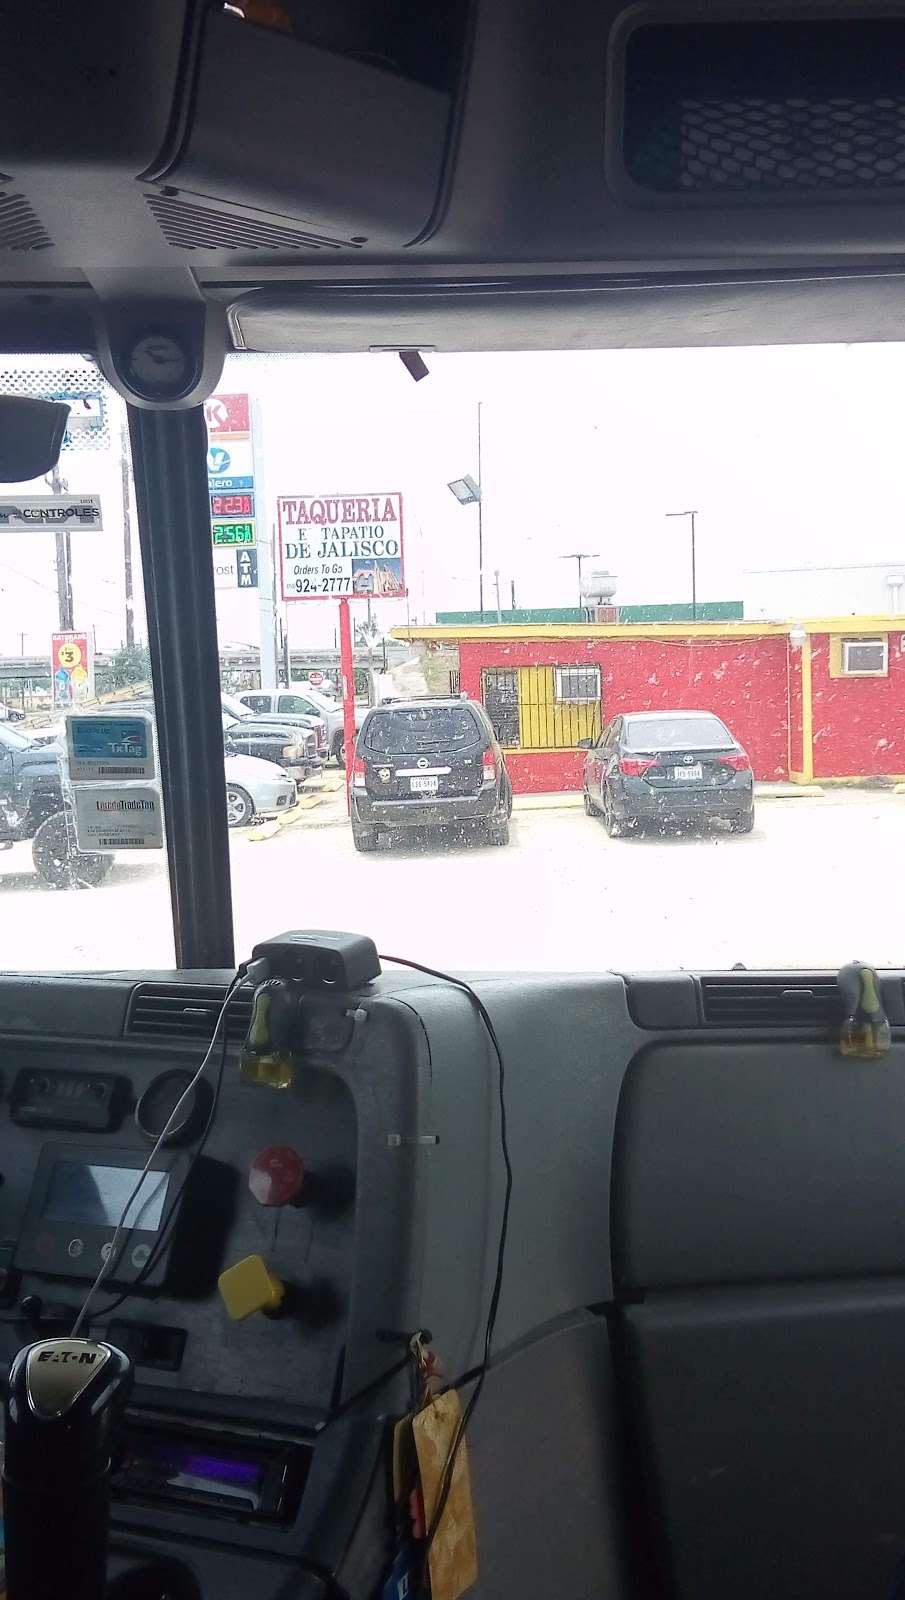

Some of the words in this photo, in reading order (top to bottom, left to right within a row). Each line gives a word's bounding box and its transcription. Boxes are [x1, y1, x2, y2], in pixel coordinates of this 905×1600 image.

[23, 508, 100, 518] CONTROLES
[282, 498, 397, 525] TAQUERIA
[321, 525, 384, 540] TAPATIO
[285, 543, 311, 559] DE
[317, 540, 399, 558] JALISCO
[240, 551, 252, 586] ATM
[293, 565, 319, 575] Orders
[321, 564, 330, 574] To
[332, 564, 343, 574] Go
[295, 577, 350, 593] 924-2777
[107, 742, 142, 756] TxTag
[38, 1351, 97, 1364] ETN
